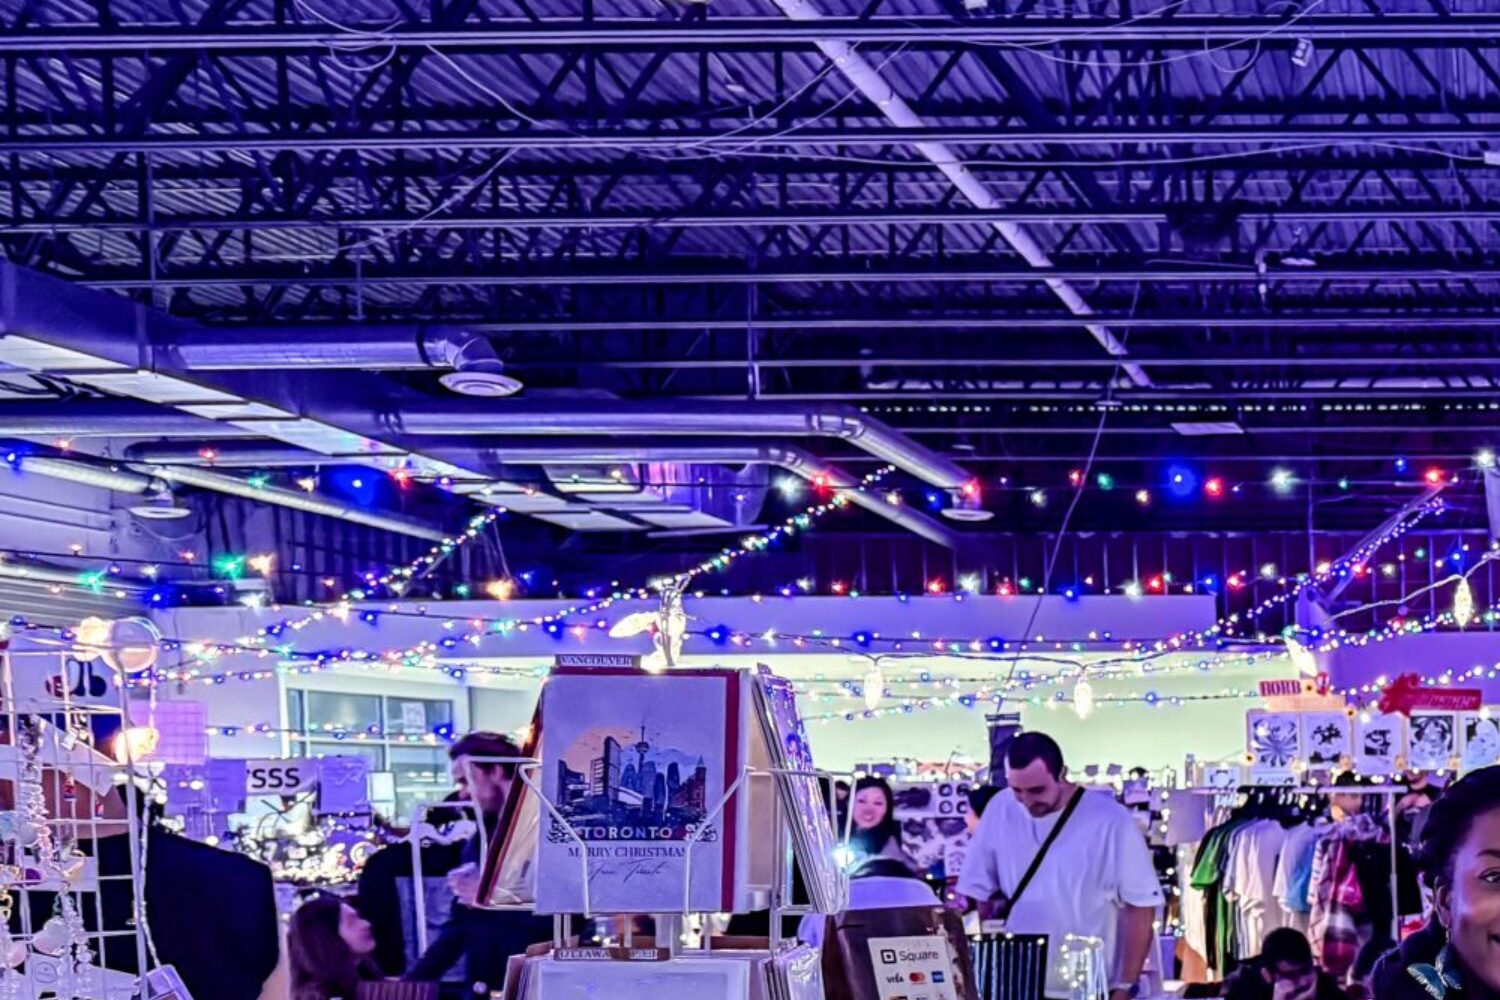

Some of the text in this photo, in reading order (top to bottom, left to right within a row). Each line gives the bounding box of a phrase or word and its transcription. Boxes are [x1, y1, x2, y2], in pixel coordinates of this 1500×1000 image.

[559, 655, 631, 667] VANCOUVER
[246, 767, 300, 789] SSS
[584, 826, 673, 840] TORONTO
[899, 948, 940, 962] Square
